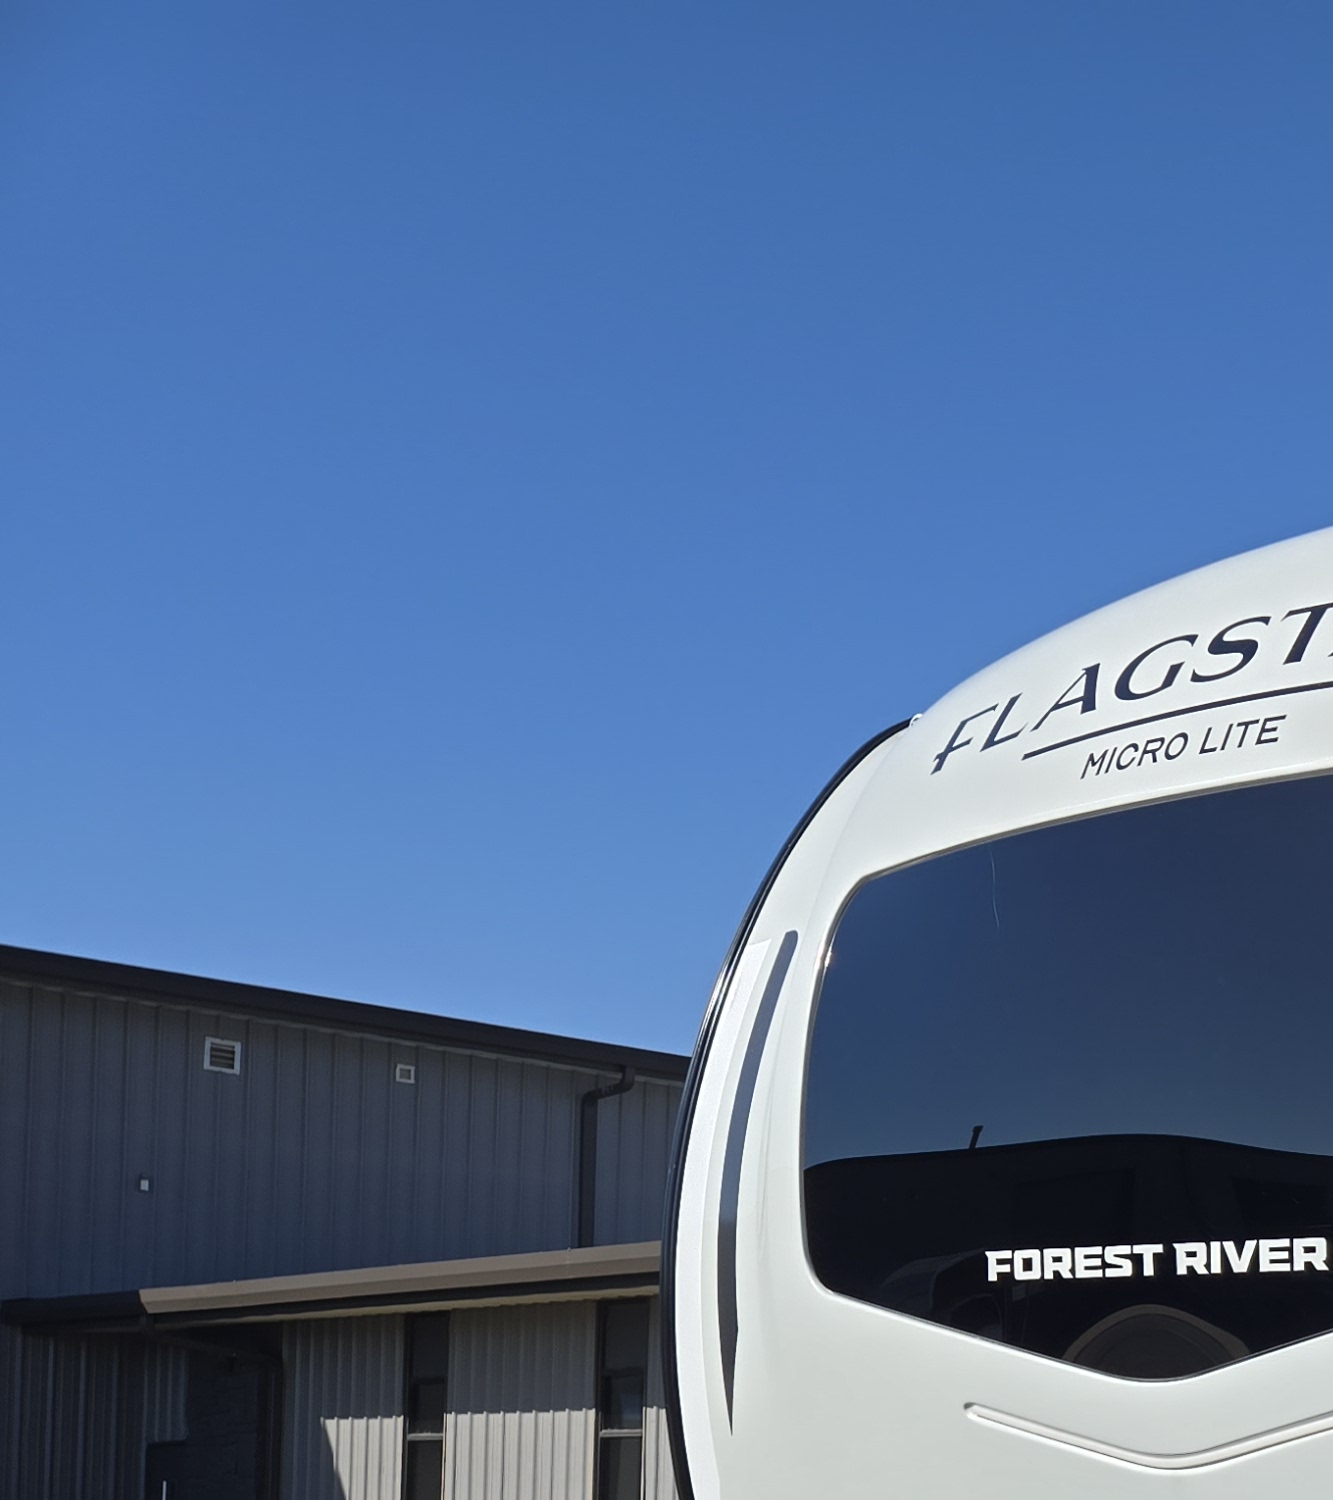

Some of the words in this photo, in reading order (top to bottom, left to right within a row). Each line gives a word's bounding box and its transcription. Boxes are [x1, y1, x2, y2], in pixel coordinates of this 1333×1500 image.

[1080, 731, 1189, 780] MICRO
[1198, 714, 1288, 753] LITE
[985, 1243, 1164, 1281] FOREST
[1172, 1237, 1329, 1275] RIVER
